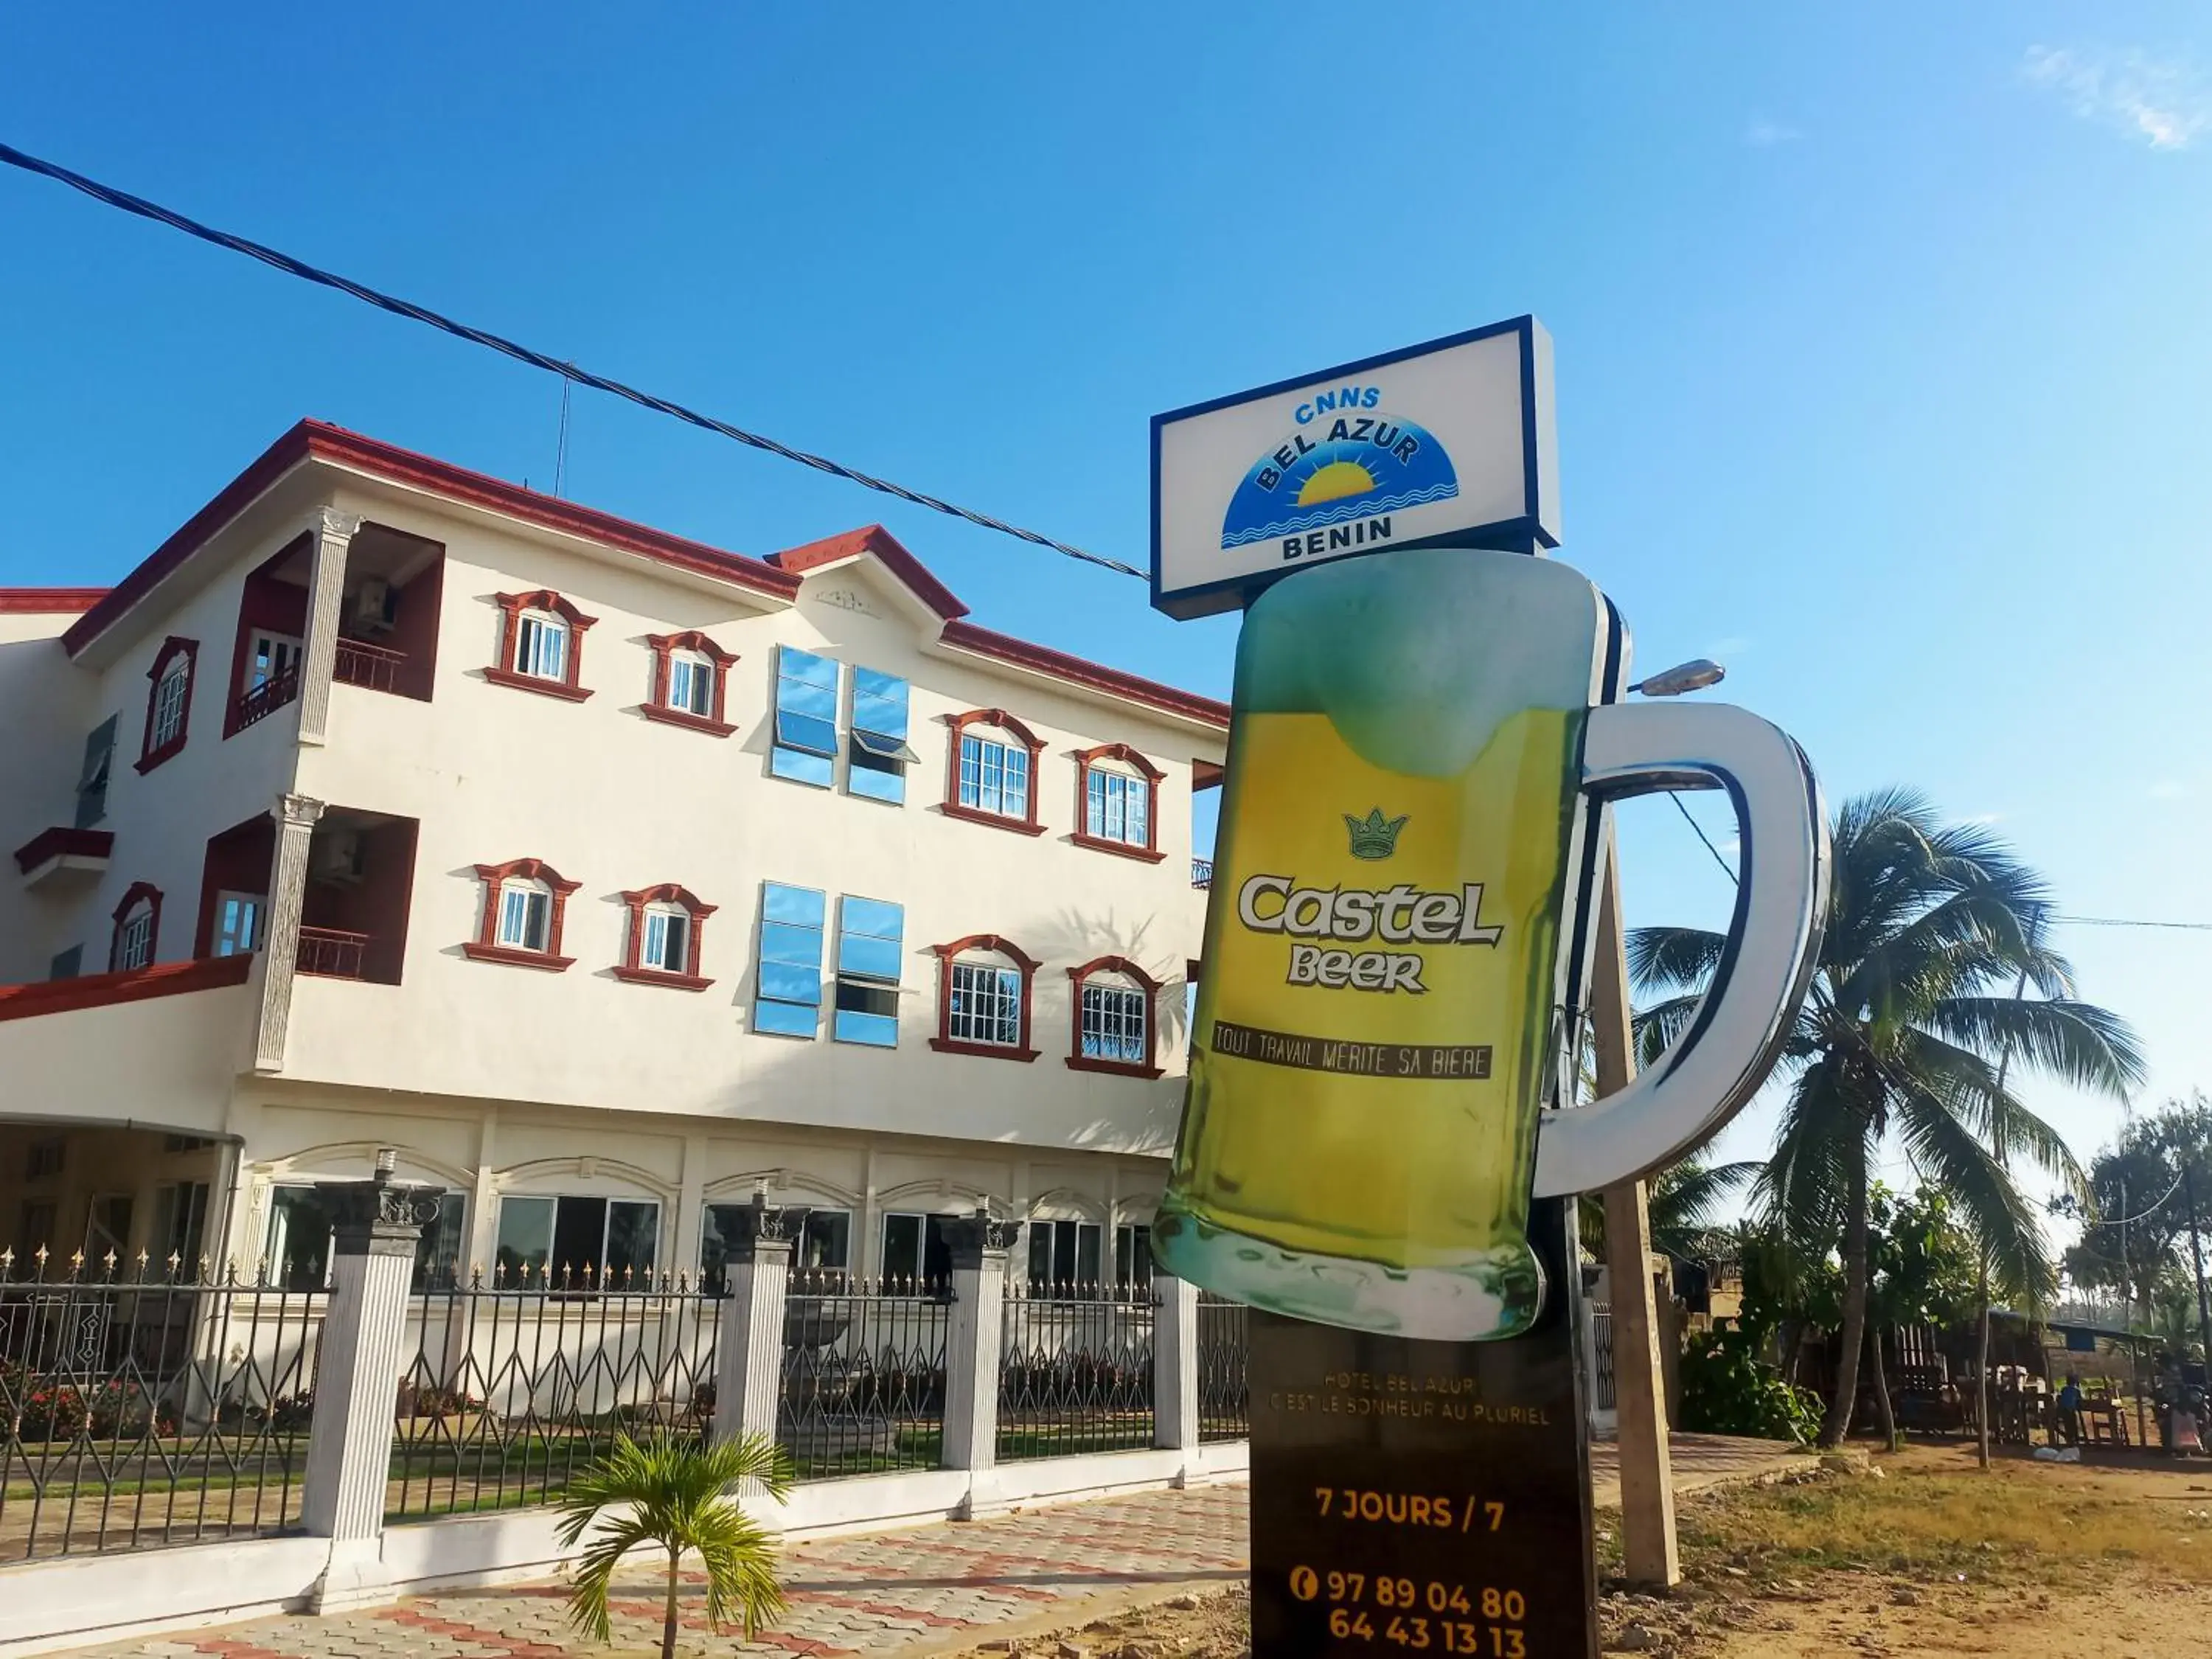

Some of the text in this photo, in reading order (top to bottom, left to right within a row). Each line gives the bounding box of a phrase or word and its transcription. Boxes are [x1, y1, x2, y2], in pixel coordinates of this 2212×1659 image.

[1295, 386, 1381, 425] CNNS
[1256, 418, 1421, 492] BEL AZUR
[1283, 517, 1392, 560] BENIN
[1216, 1026, 1251, 1054] TOUT
[1260, 1034, 1313, 1066] TRAVAIL
[1399, 1048, 1422, 1074] SA
[1386, 1373, 1419, 1392] BEL
[1425, 1376, 1475, 1395] AZUR
[1321, 1394, 1339, 1413] LE
[1347, 1396, 1434, 1417] BONHEUR
[1442, 1402, 1467, 1421] AU
[1473, 1404, 1551, 1426] PLURIEL
[1315, 1487, 1505, 1533] 7 JOURS / 7
[1327, 1571, 1526, 1621] 97 89 04 80
[1329, 1608, 1526, 1659] 64 43 13 13
